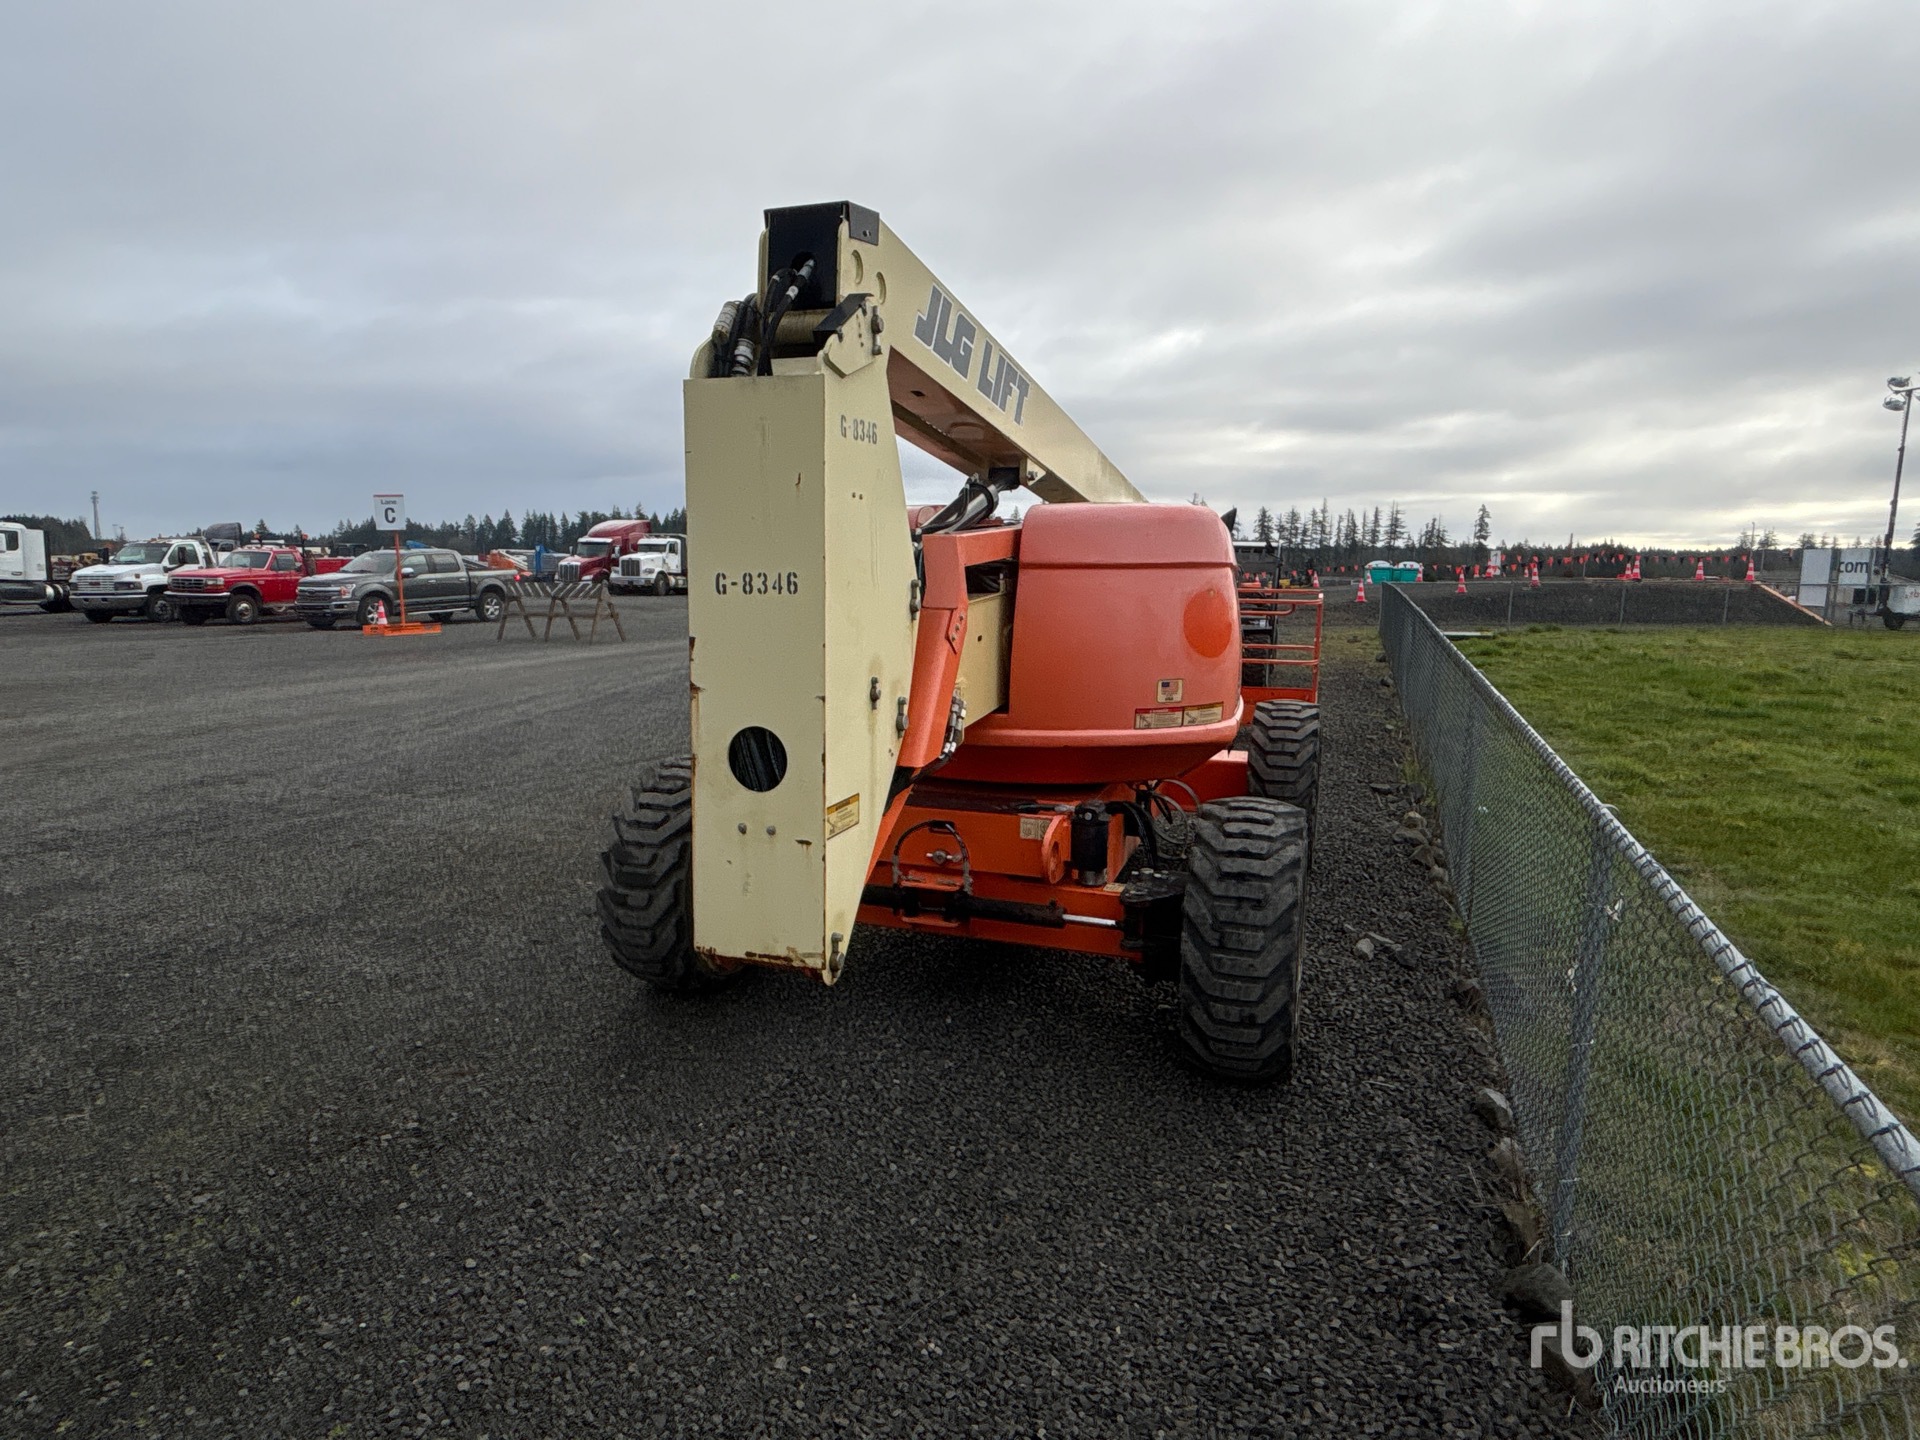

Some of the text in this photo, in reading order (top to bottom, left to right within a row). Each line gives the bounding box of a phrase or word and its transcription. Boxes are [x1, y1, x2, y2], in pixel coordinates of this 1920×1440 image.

[914, 284, 1030, 427] JLG LIFT
[840, 414, 878, 445] G-8346
[384, 507, 396, 524] C
[714, 571, 799, 596] G-8346
